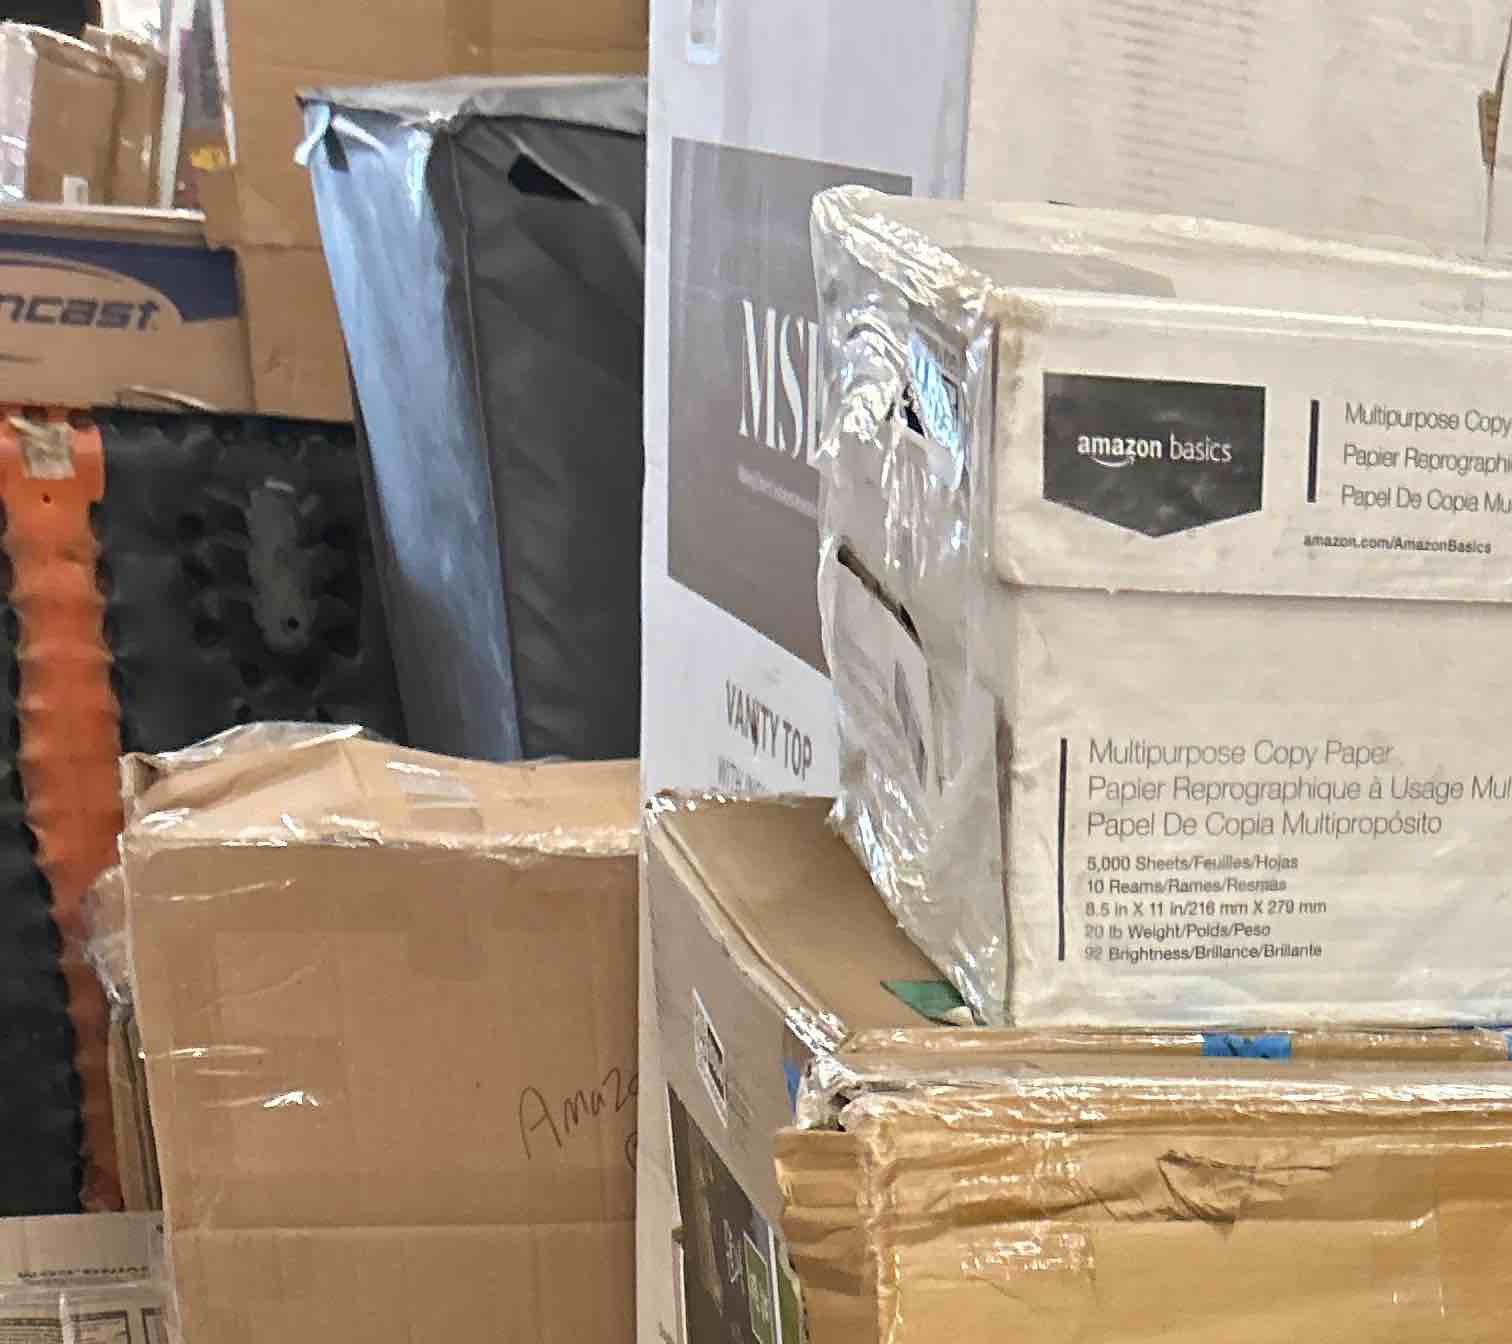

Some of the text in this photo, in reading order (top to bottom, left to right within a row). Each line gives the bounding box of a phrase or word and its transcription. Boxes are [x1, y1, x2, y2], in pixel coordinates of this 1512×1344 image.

[1345, 401, 1459, 431] Multipurpose
[1465, 409, 1512, 437] Copy
[1077, 432, 1232, 462] amazon basics
[1343, 443, 1399, 470] Papier
[1342, 483, 1392, 510] Papel
[1397, 487, 1423, 509] De
[1427, 488, 1479, 513] Copia
[1303, 535, 1492, 554] amazon.com/AmazonBasics
[726, 680, 813, 782] VANITY TOP
[1089, 737, 1395, 770] Multipurpose Copy Paper
[1088, 775, 1167, 808] Papier
[1173, 775, 1361, 806] Reprographique
[1368, 776, 1383, 800] à
[1391, 776, 1464, 805] Usage
[1087, 810, 1443, 842] Papel De Copia Multipropósito
[1087, 854, 1299, 873] 5,000 Sheets/Feuilles/Hojas
[1088, 877, 1287, 894] 10 Reams/Rames/Resmas
[1115, 901, 1129, 916] in
[1133, 902, 1145, 916] X
[1150, 902, 1164, 916] 11
[1219, 903, 1249, 914] mm
[1252, 901, 1264, 914] X
[1299, 902, 1327, 913] mm
[1109, 924, 1122, 938] lb
[1128, 923, 1271, 942] Weight/Poids/Peso
[1108, 944, 1323, 965] Brightness/Brillance/Brillante
